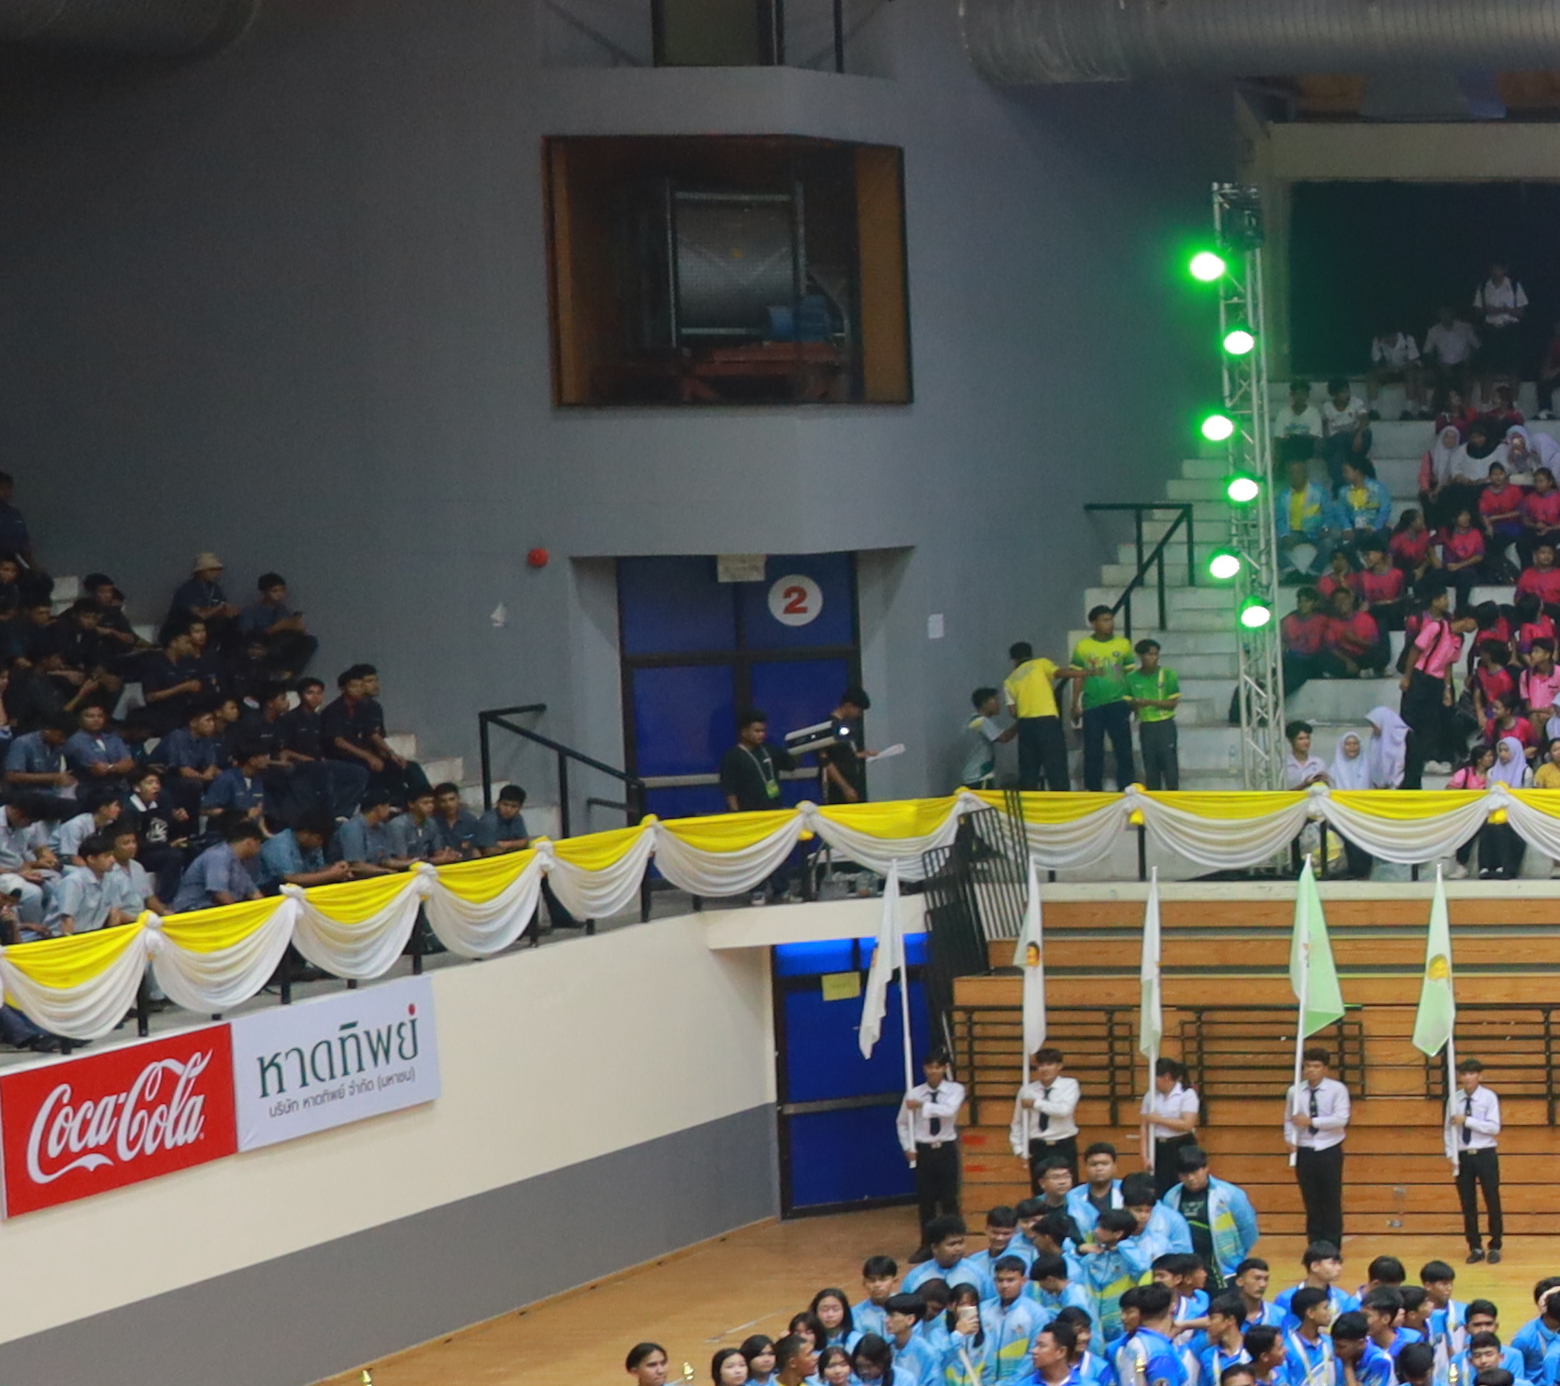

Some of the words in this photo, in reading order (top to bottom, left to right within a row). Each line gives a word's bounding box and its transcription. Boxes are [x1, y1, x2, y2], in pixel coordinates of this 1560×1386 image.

[782, 586, 808, 614] 2
[257, 1003, 418, 1098] หาดทิพย์
[27, 1048, 213, 1184] Coca-Cola
[269, 1098, 299, 1118] บริษัท
[302, 1084, 345, 1109] หาดทิพย์
[349, 1078, 374, 1097] จำกัด
[377, 1066, 415, 1092] (มหาชน)
